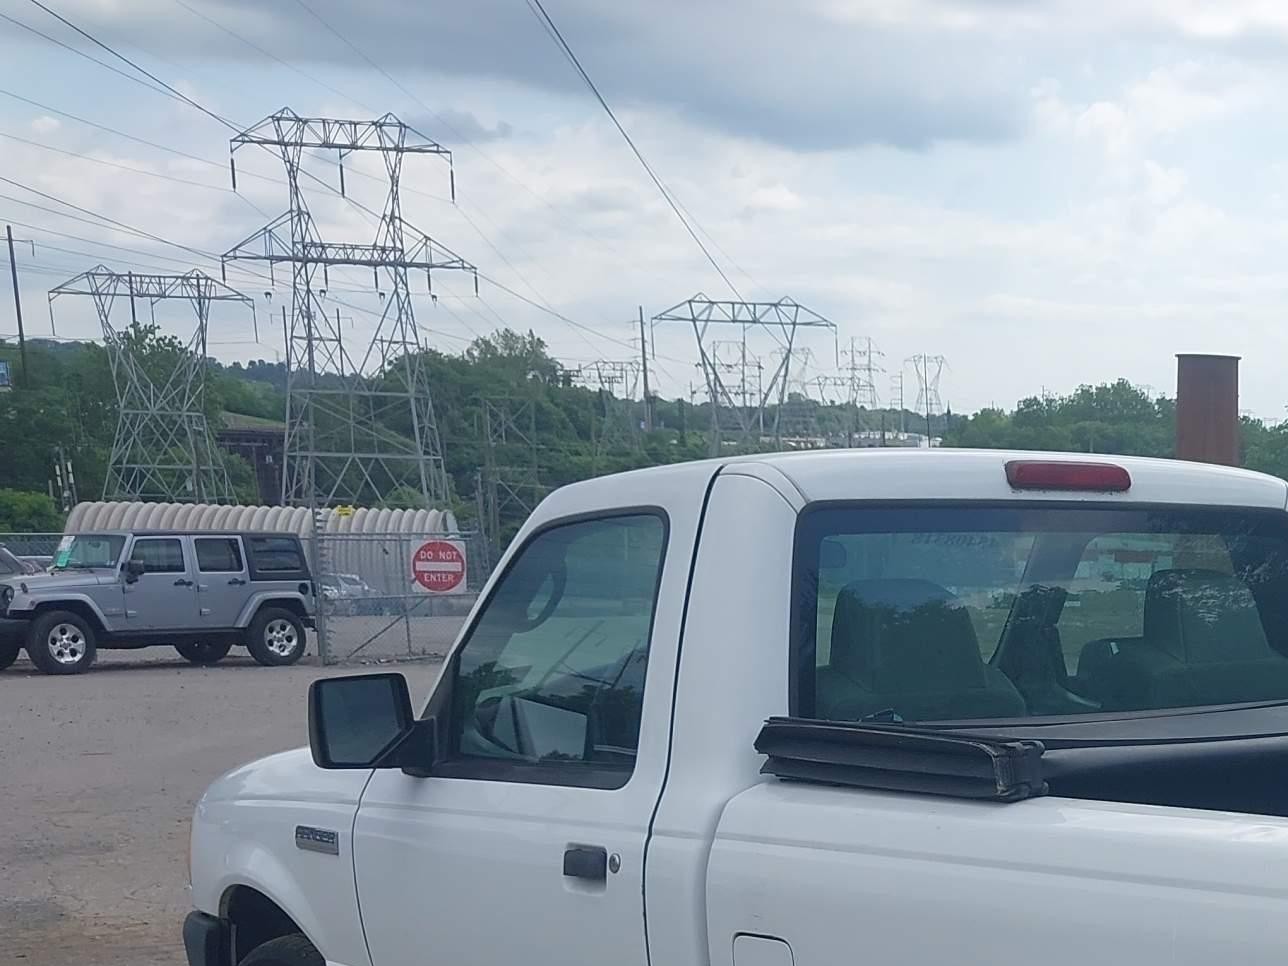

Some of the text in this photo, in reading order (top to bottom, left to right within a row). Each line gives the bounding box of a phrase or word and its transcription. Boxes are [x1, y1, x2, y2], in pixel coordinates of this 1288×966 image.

[420, 551, 457, 560] DO NOT
[424, 573, 454, 582] ENTER
